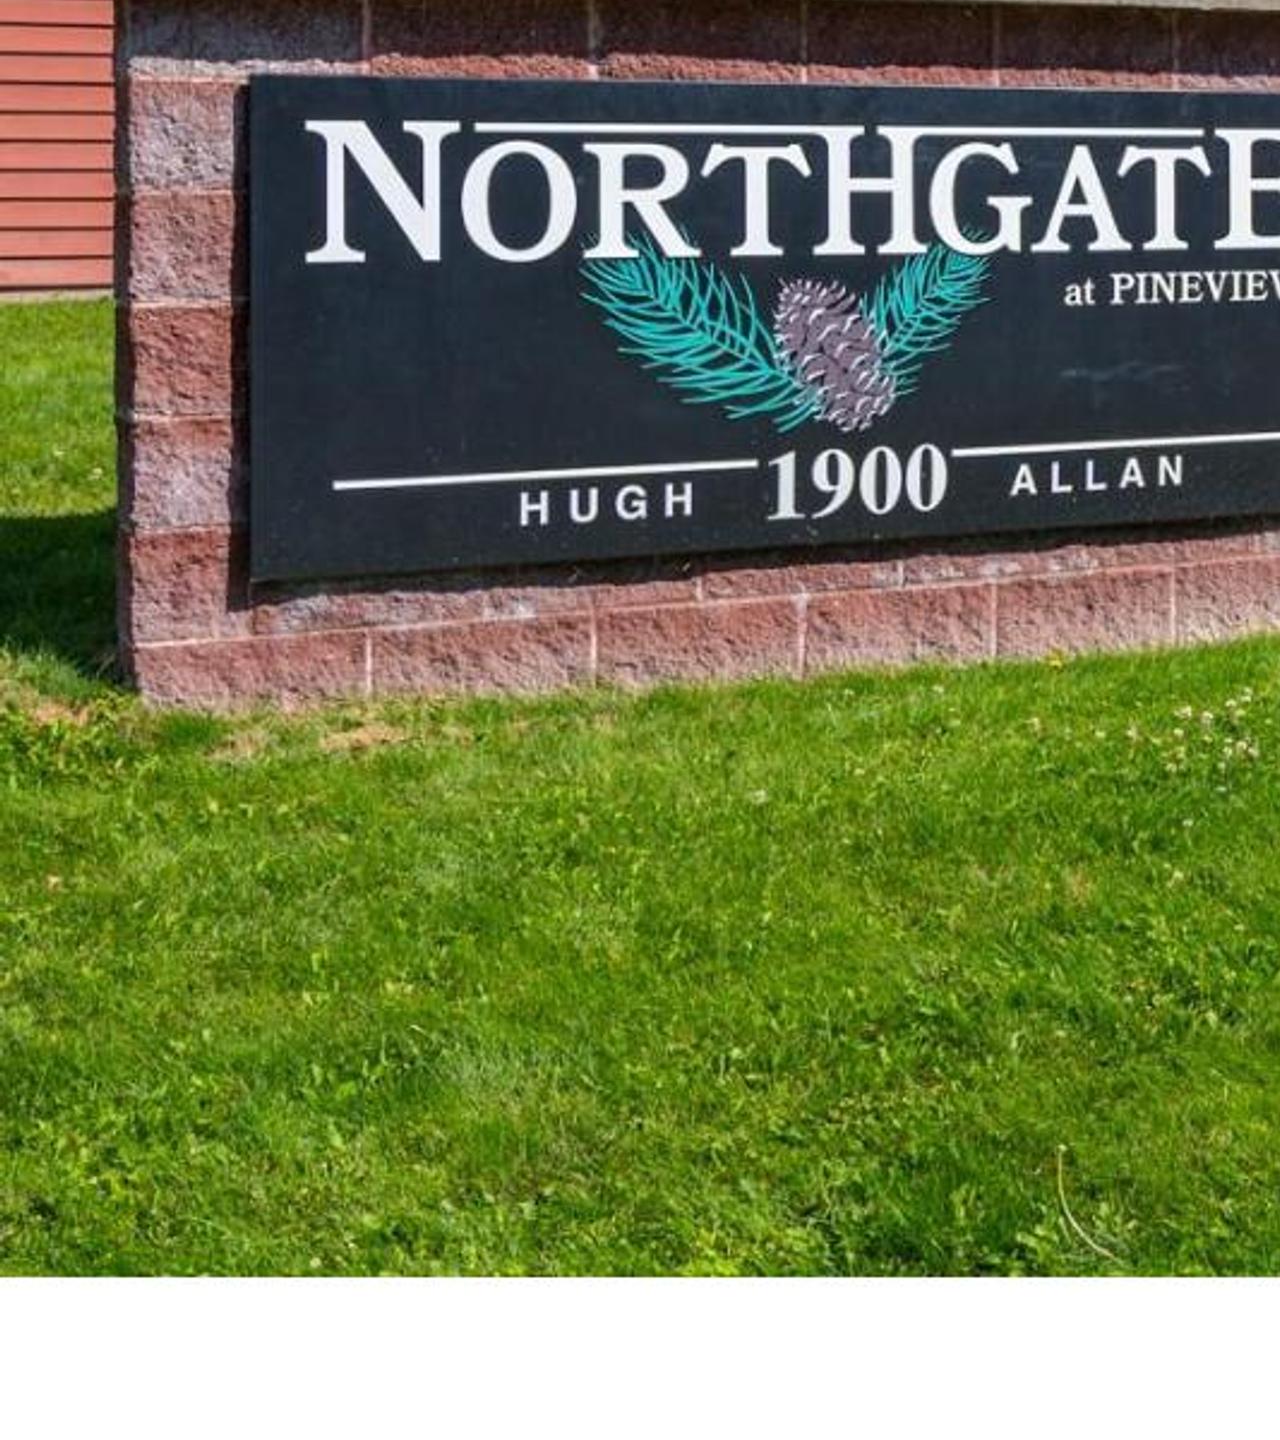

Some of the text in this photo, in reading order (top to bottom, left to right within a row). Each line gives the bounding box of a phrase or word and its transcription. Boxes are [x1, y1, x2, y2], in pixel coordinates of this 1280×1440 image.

[1064, 278, 1096, 305] at
[519, 443, 1184, 526] HUGH 1900 ALLAN
